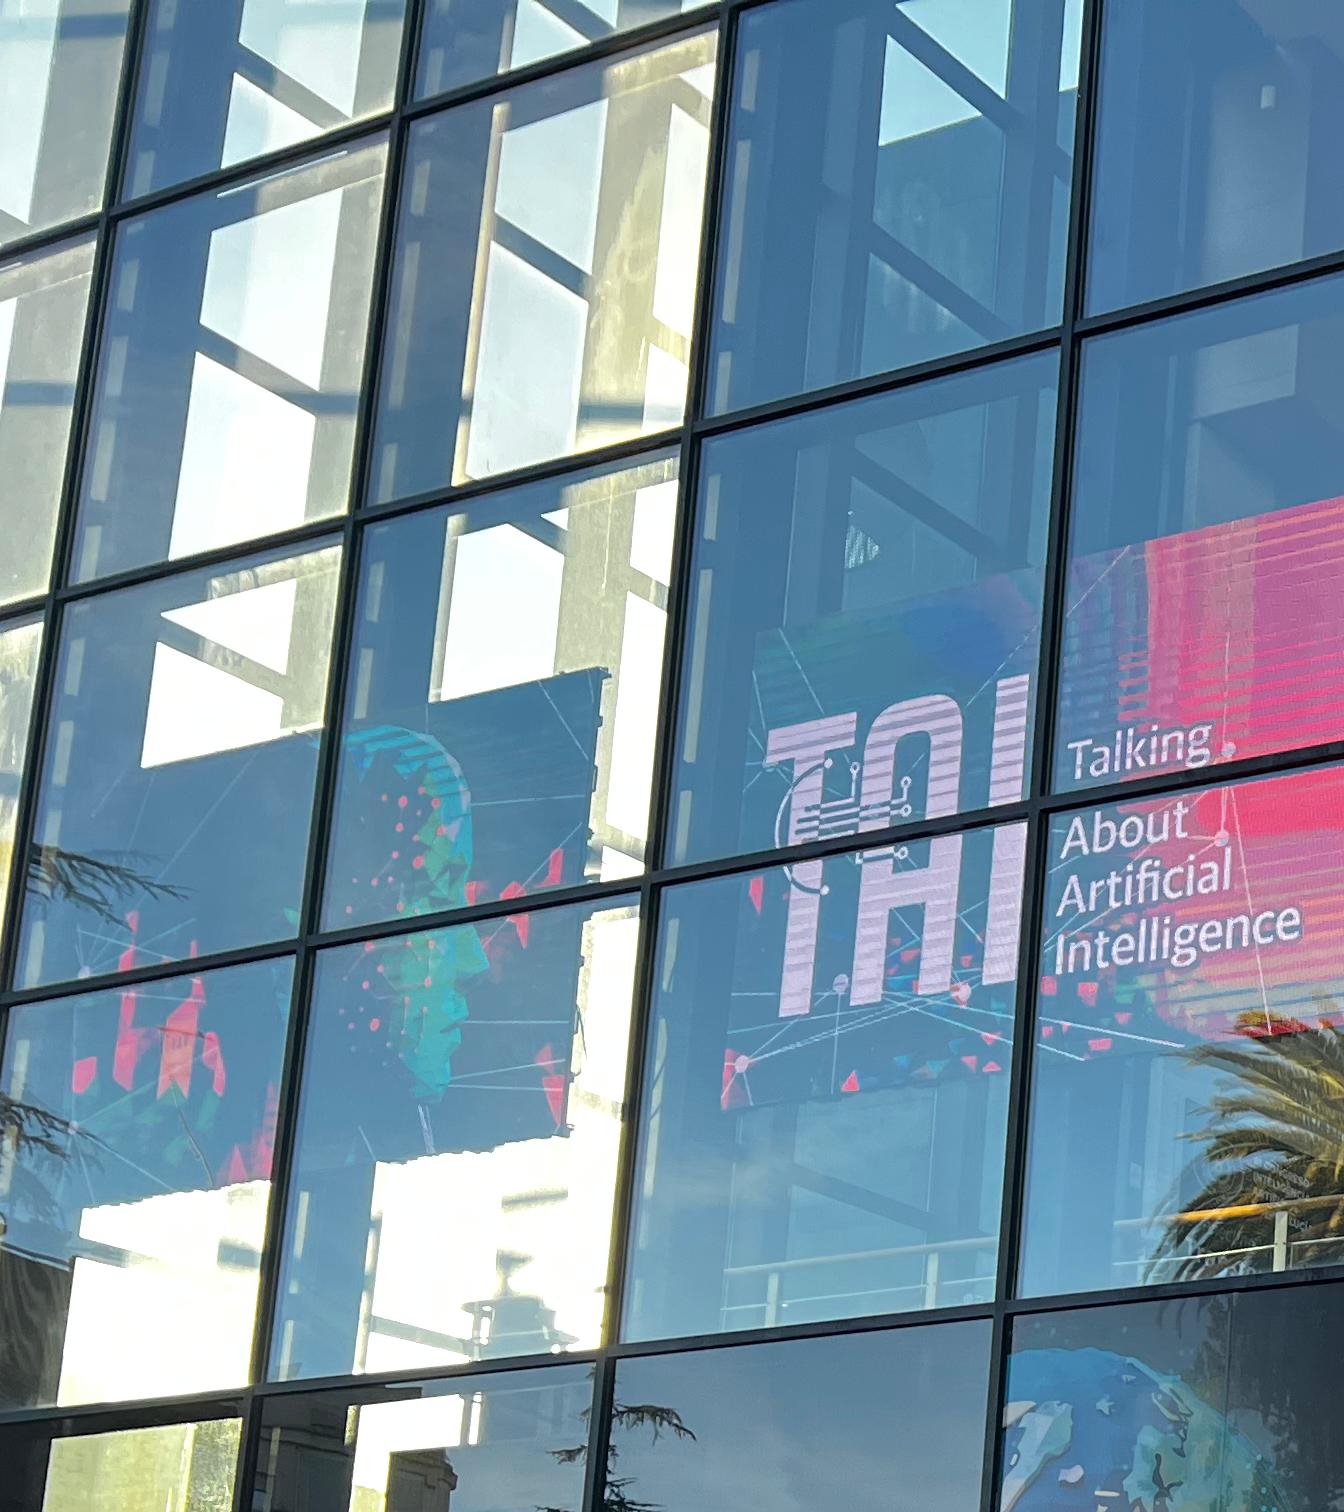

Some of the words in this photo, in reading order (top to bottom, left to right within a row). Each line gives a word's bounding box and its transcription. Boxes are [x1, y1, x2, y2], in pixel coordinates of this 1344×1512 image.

[1067, 721, 1213, 780] Talking
[764, 672, 1030, 1019] TAI
[1059, 799, 1189, 860] About
[1056, 848, 1234, 918] Artificial
[1053, 905, 1303, 977] Intelligence
